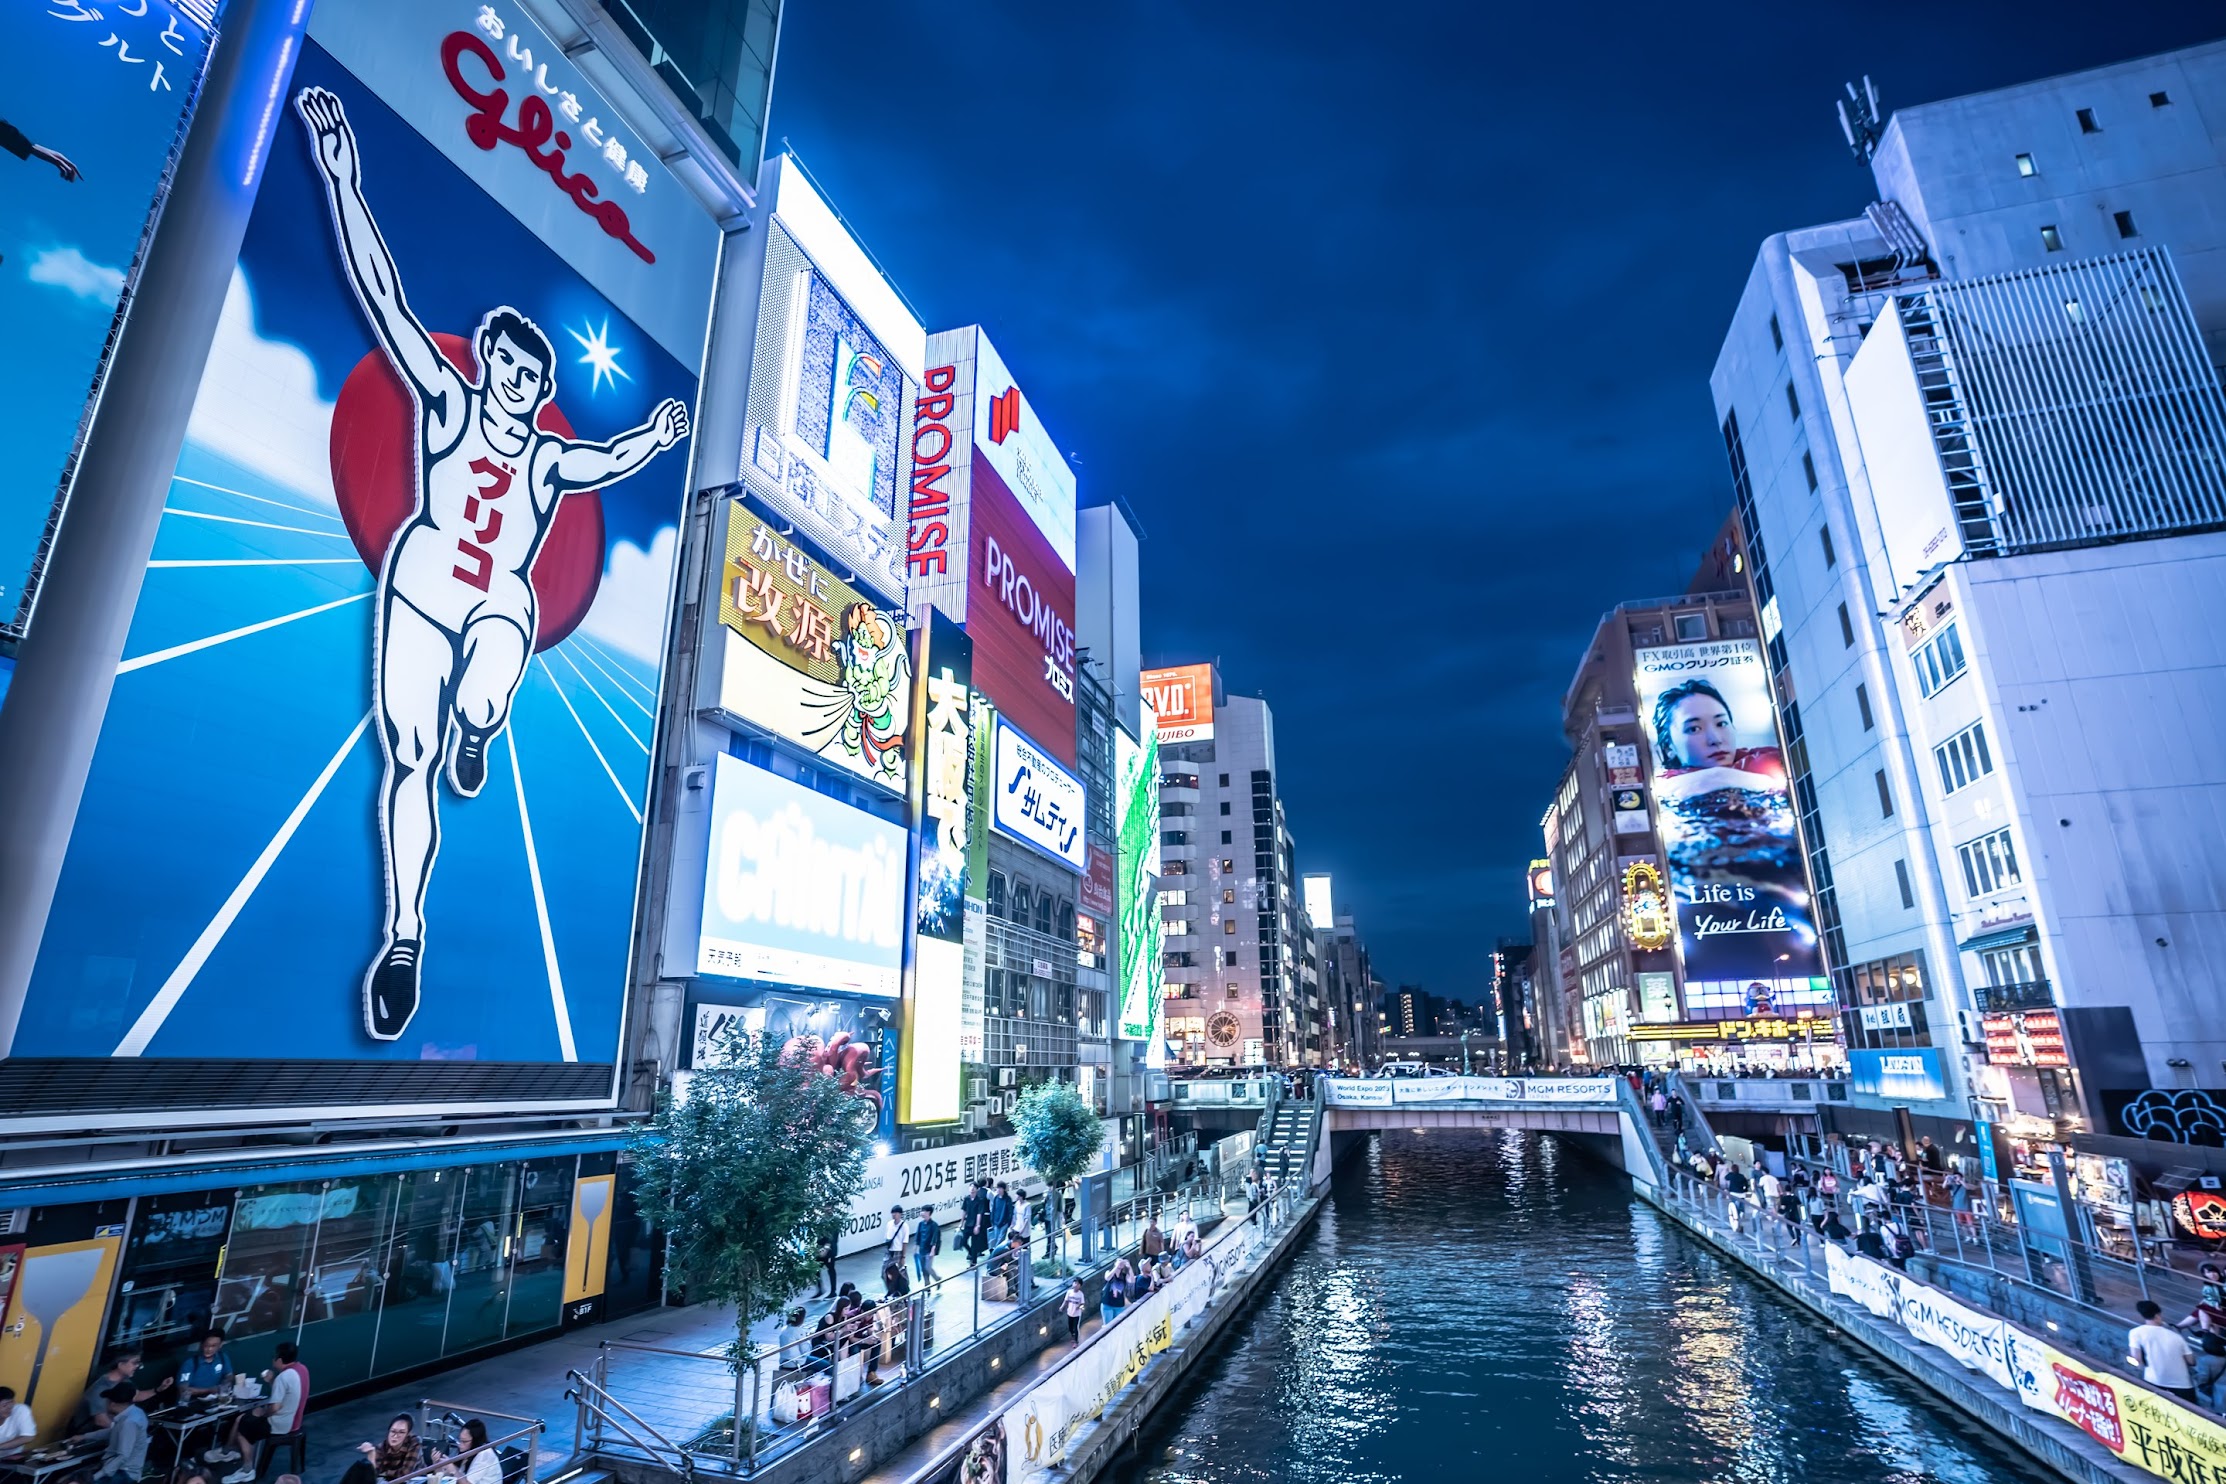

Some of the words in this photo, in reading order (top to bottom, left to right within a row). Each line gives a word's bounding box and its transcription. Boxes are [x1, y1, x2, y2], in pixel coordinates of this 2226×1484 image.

[476, 4, 649, 194] おいしさと健康
[441, 31, 656, 265] Glico
[906, 366, 955, 577] PROMISE
[452, 456, 517, 593] グリコ
[752, 523, 830, 603] かぜに
[732, 556, 835, 664] 改源
[984, 535, 1075, 674] PROMISE
[1044, 655, 1076, 705] プロミス
[1644, 655, 1754, 673] GMOクリック証券
[1157, 728, 1195, 742] UJIBO
[1688, 883, 1732, 904] Life
[1736, 883, 1755, 902] is
[1694, 914, 1742, 940] Your
[1879, 1055, 1925, 1075] LAWSON
[1357, 1085, 1373, 1093] Expo
[1527, 1085, 1554, 1094] MGM
[1557, 1084, 1611, 1094] RESORTS
[900, 1159, 958, 1198] 2025年
[839, 1211, 882, 1237] PO2025
